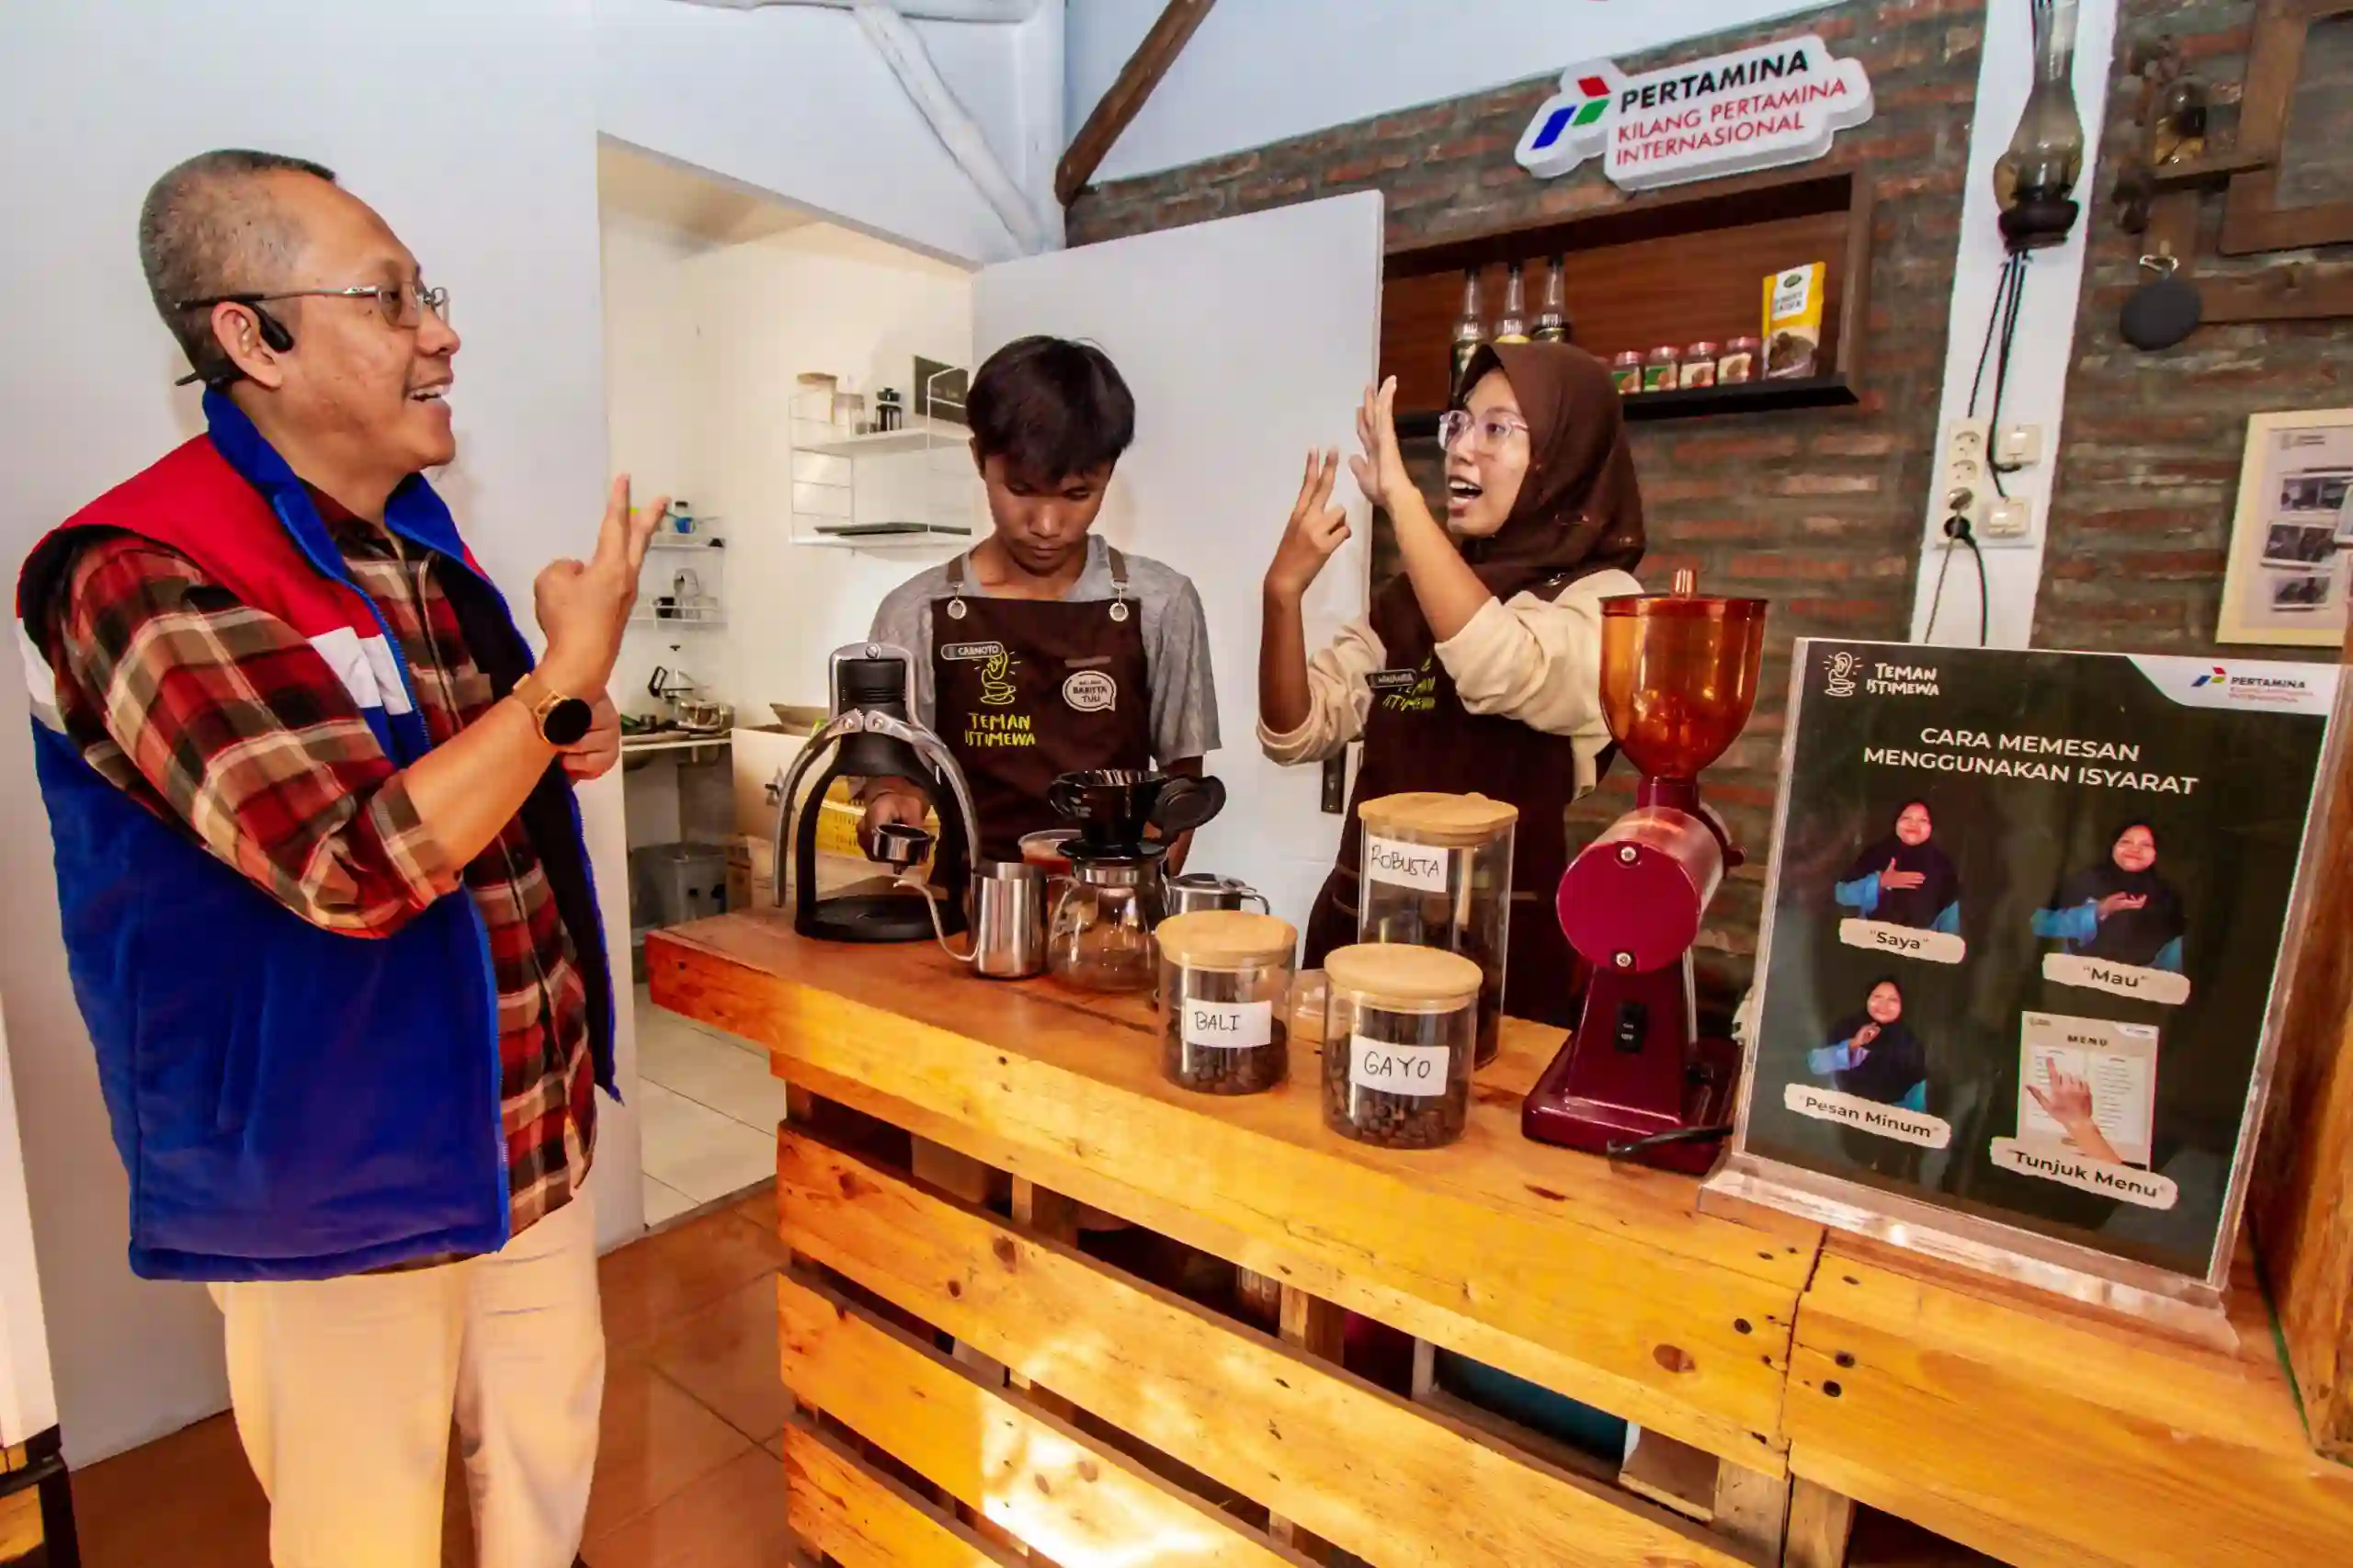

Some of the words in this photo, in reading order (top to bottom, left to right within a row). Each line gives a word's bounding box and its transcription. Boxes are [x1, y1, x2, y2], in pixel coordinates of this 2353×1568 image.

[1620, 50, 1809, 113] PERTAMINA
[1617, 110, 1701, 143] KILANG
[1710, 78, 1847, 123] PERTAMINA
[1615, 112, 1805, 165] INTERNASIONAL
[1874, 663, 1938, 681] TEMAN
[2231, 676, 2305, 688] PERTAMINA
[970, 712, 1030, 730] TEMAN
[1920, 727, 1991, 750] CARA
[1998, 733, 2141, 762] MEMESAN
[1863, 746, 2070, 783] MENGGUNAKAN
[2077, 767, 2200, 796] ISYARAT
[1370, 843, 1439, 878] ROBUSTA
[1194, 1010, 1241, 1032] BALI
[1363, 1051, 1431, 1079] GAYO
